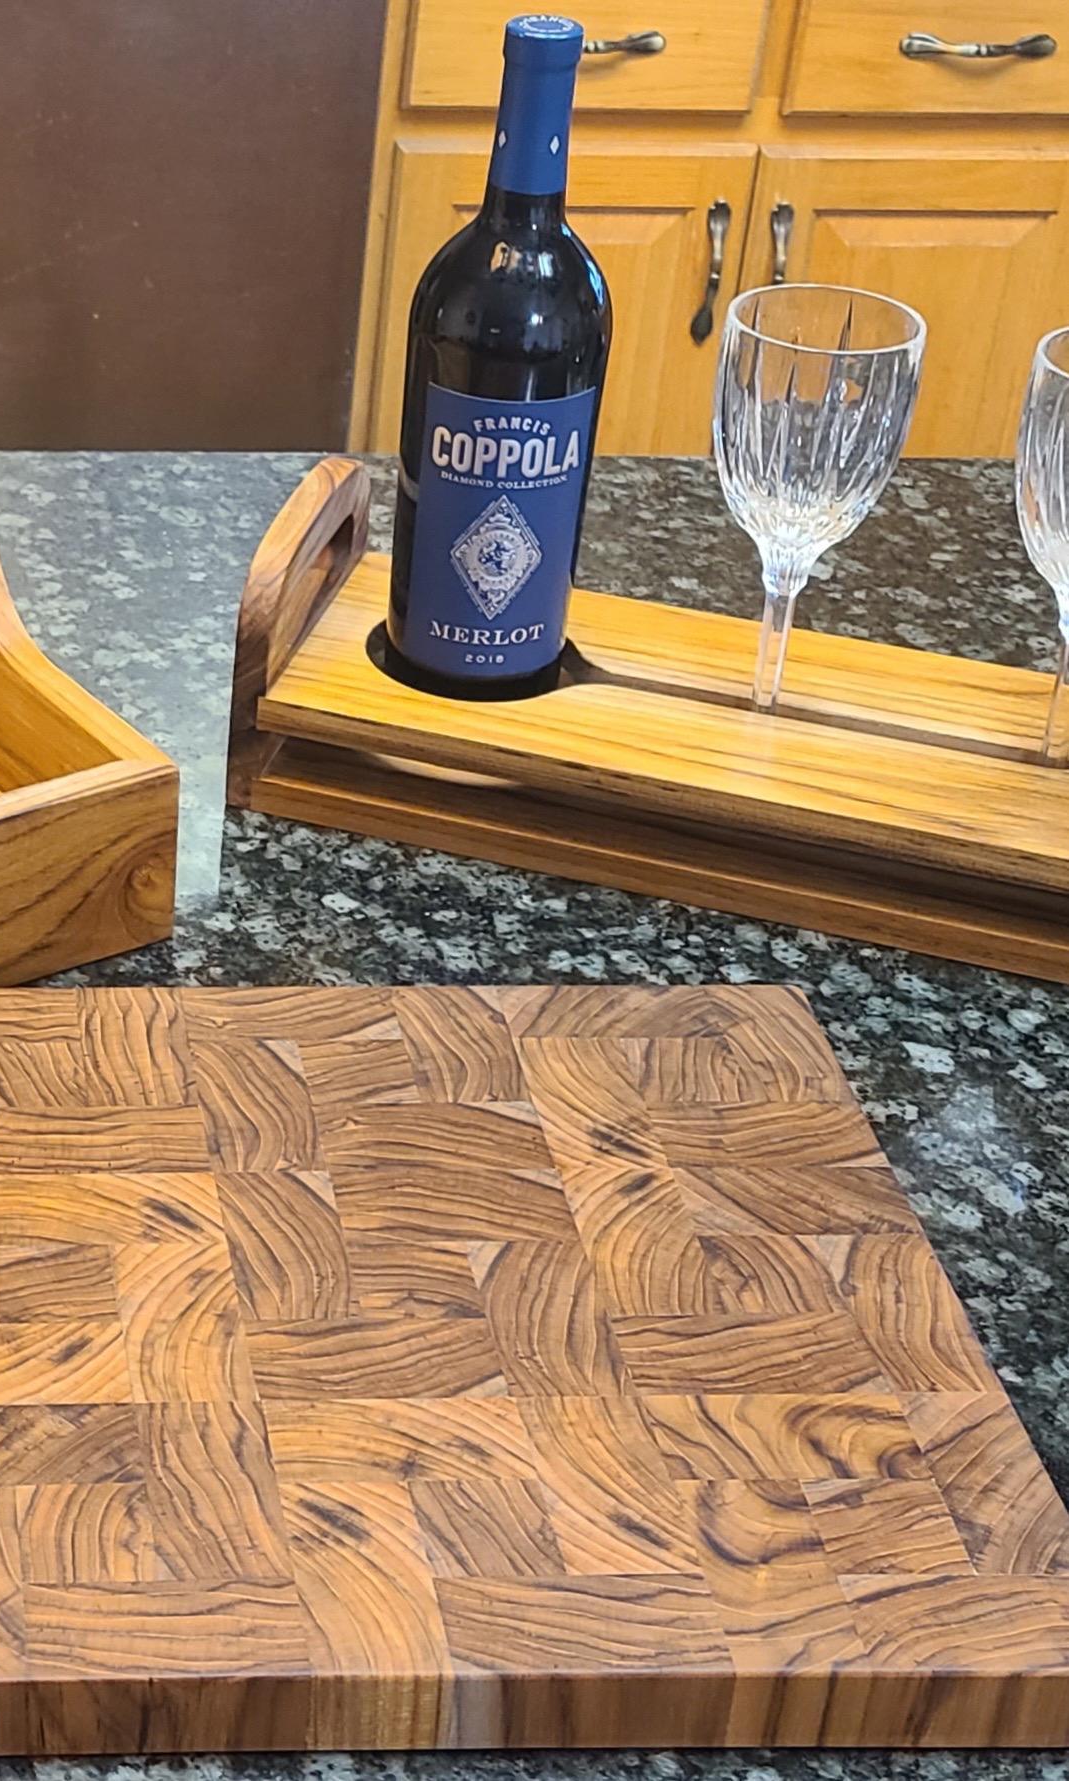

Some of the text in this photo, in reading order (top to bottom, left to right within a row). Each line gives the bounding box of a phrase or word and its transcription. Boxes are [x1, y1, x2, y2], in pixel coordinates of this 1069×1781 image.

[473, 416, 551, 435] FRANCIS
[432, 426, 579, 478] COPPOLA
[440, 470, 568, 489] DIAMOND COLLECTION
[429, 620, 544, 645] MERLOT
